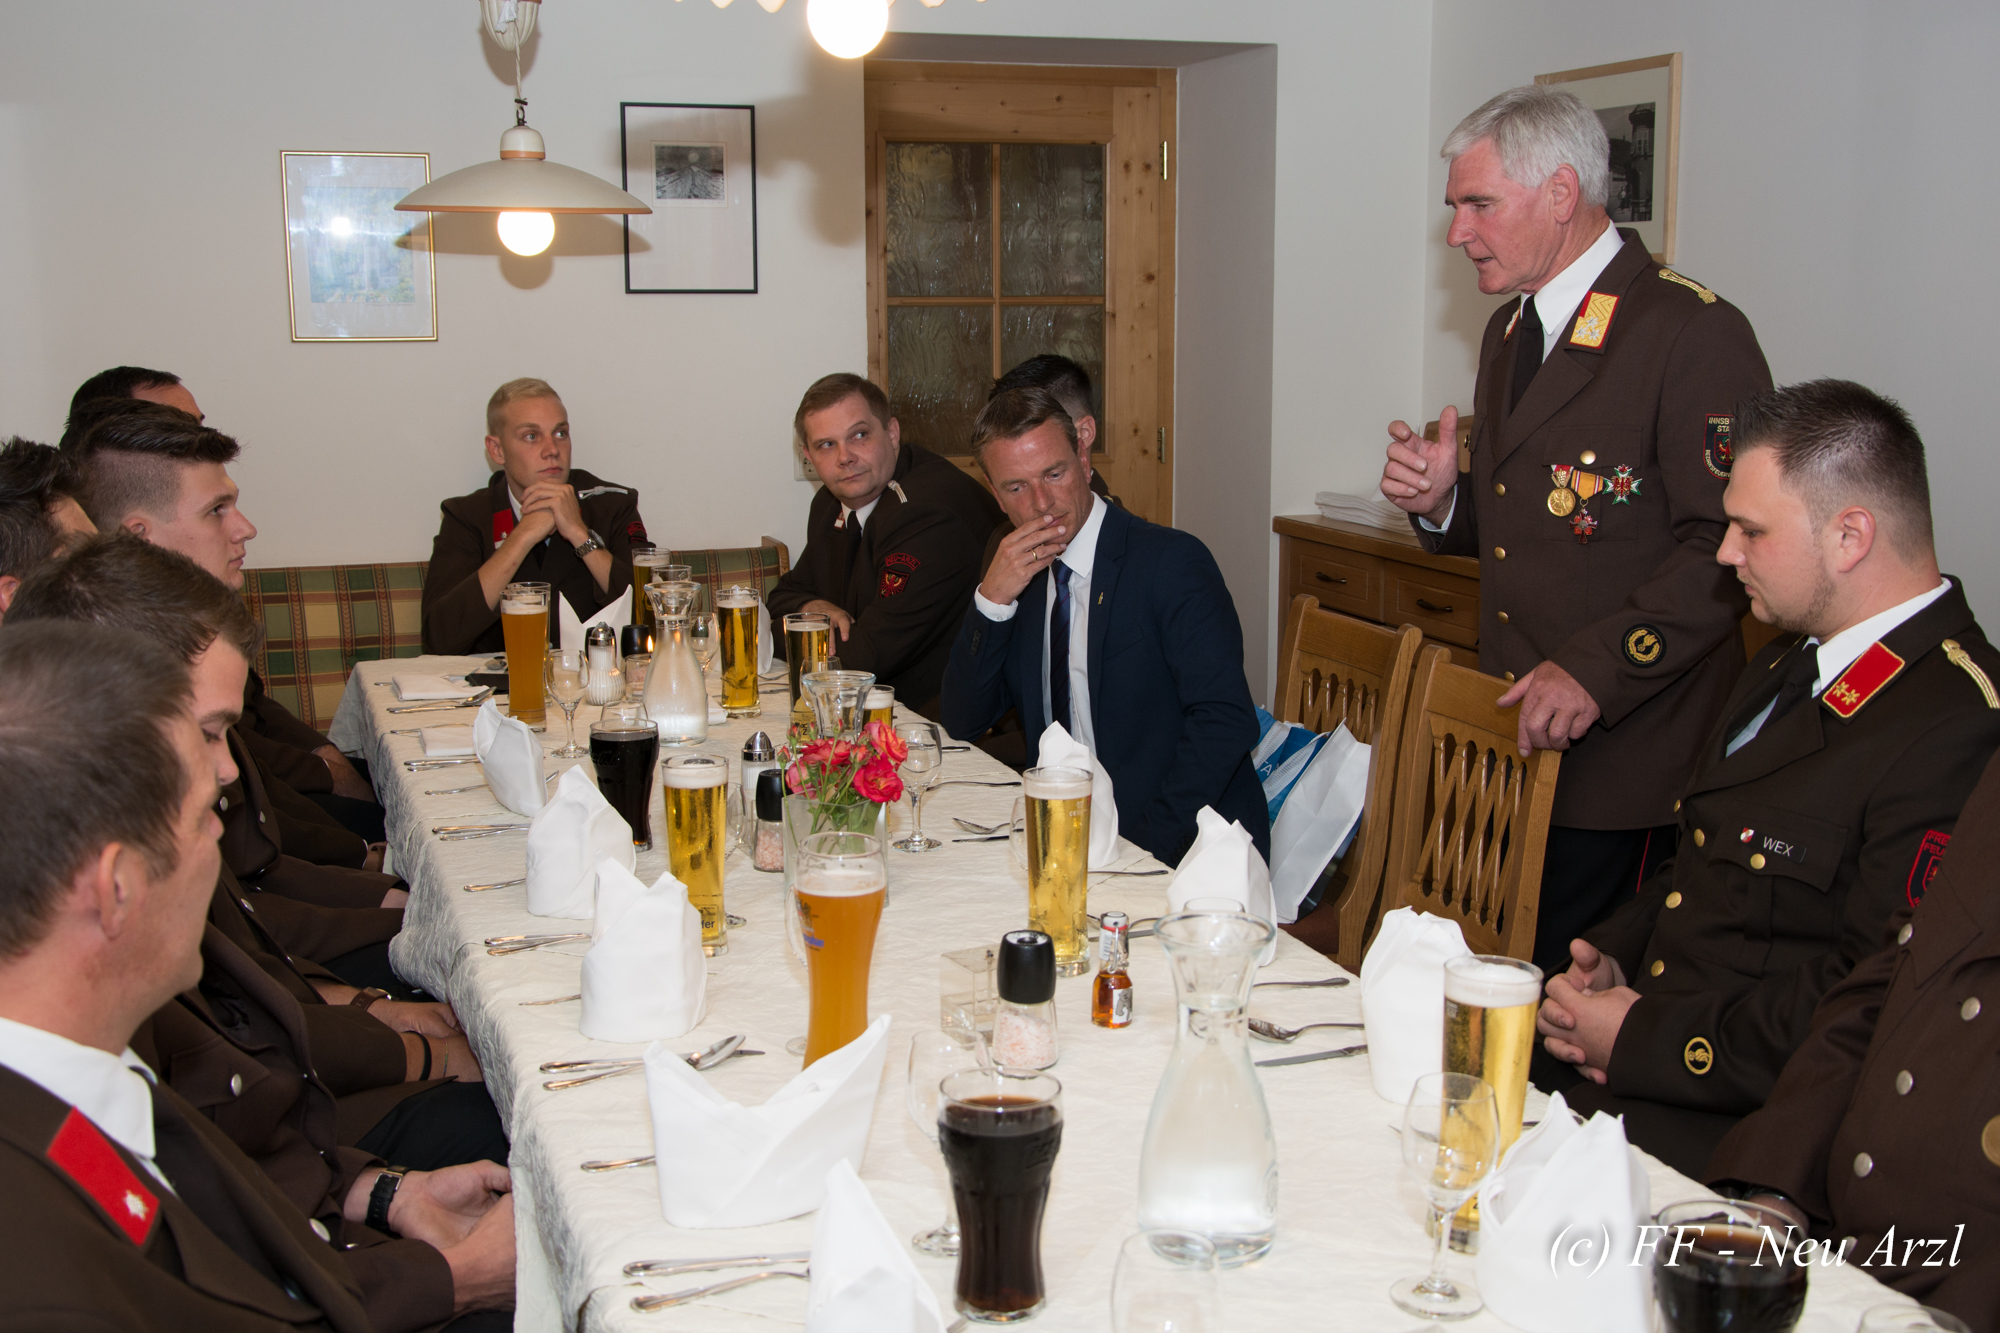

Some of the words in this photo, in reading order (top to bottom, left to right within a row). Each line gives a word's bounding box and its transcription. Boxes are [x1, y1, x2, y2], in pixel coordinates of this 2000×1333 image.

[1708, 417, 1731, 425] INNSB
[1717, 425, 1730, 433] STA
[1928, 834, 1948, 846] FRE
[1763, 836, 1794, 857] WEX
[1924, 842, 1945, 856] FEU
[701, 919, 715, 929] fer
